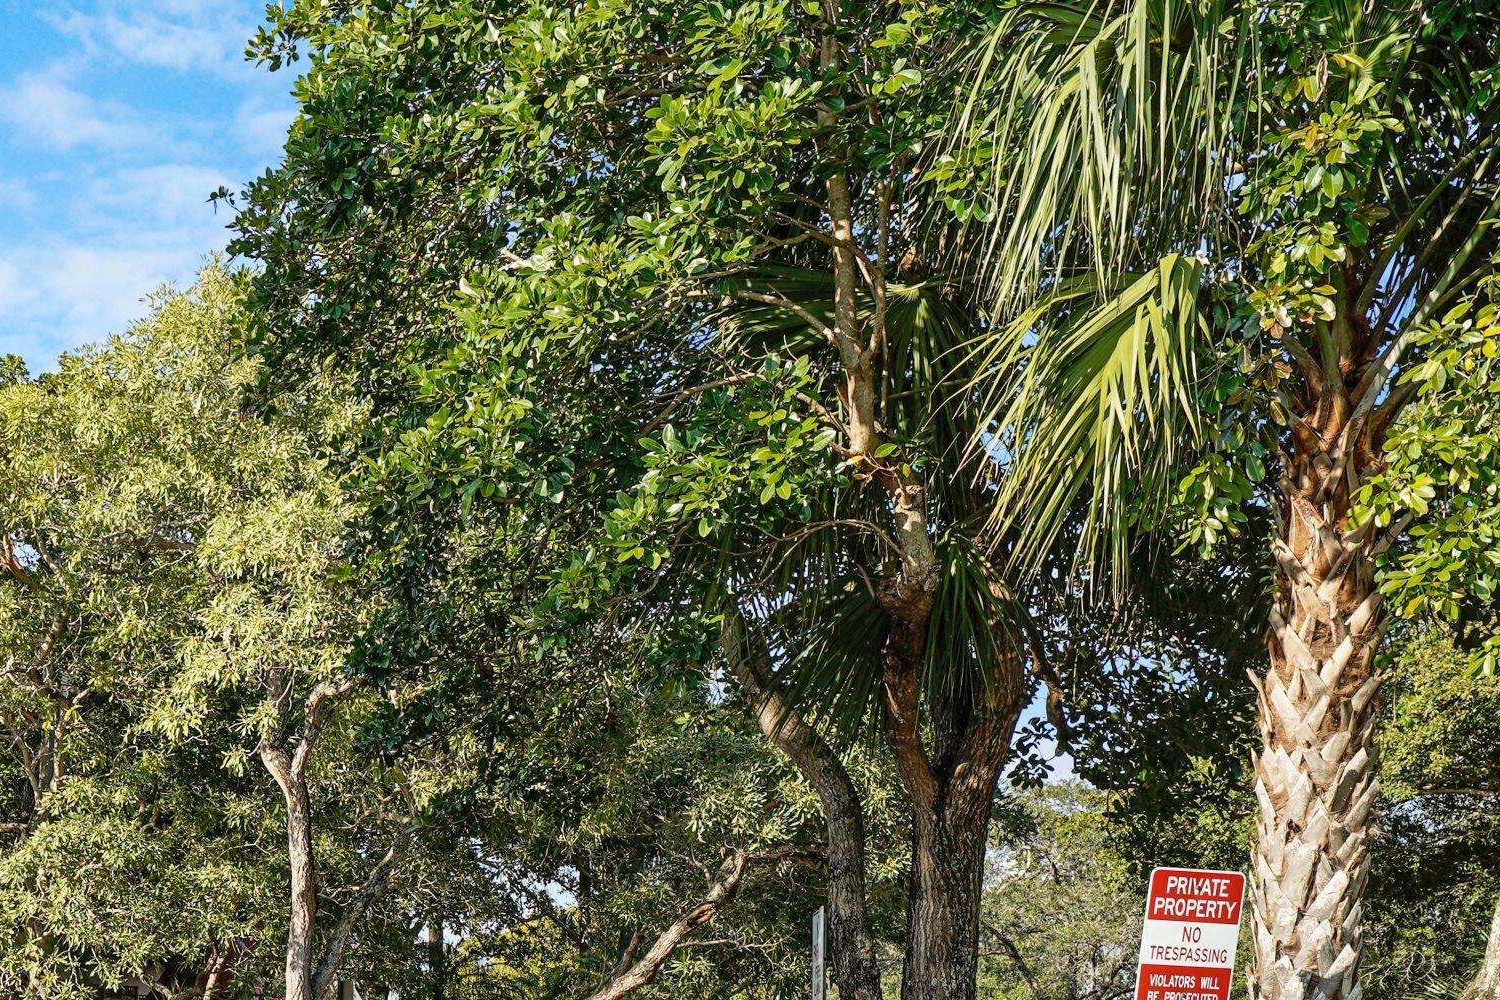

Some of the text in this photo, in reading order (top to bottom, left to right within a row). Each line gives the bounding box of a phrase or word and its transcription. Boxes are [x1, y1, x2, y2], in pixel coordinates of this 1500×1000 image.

[1166, 875, 1231, 898] PRIVATE
[1153, 896, 1237, 920] PROPERTY
[1182, 926, 1202, 944] NO
[1150, 945, 1228, 963] TRESPASSING
[1149, 974, 1220, 990] VIOLATORS WILL
